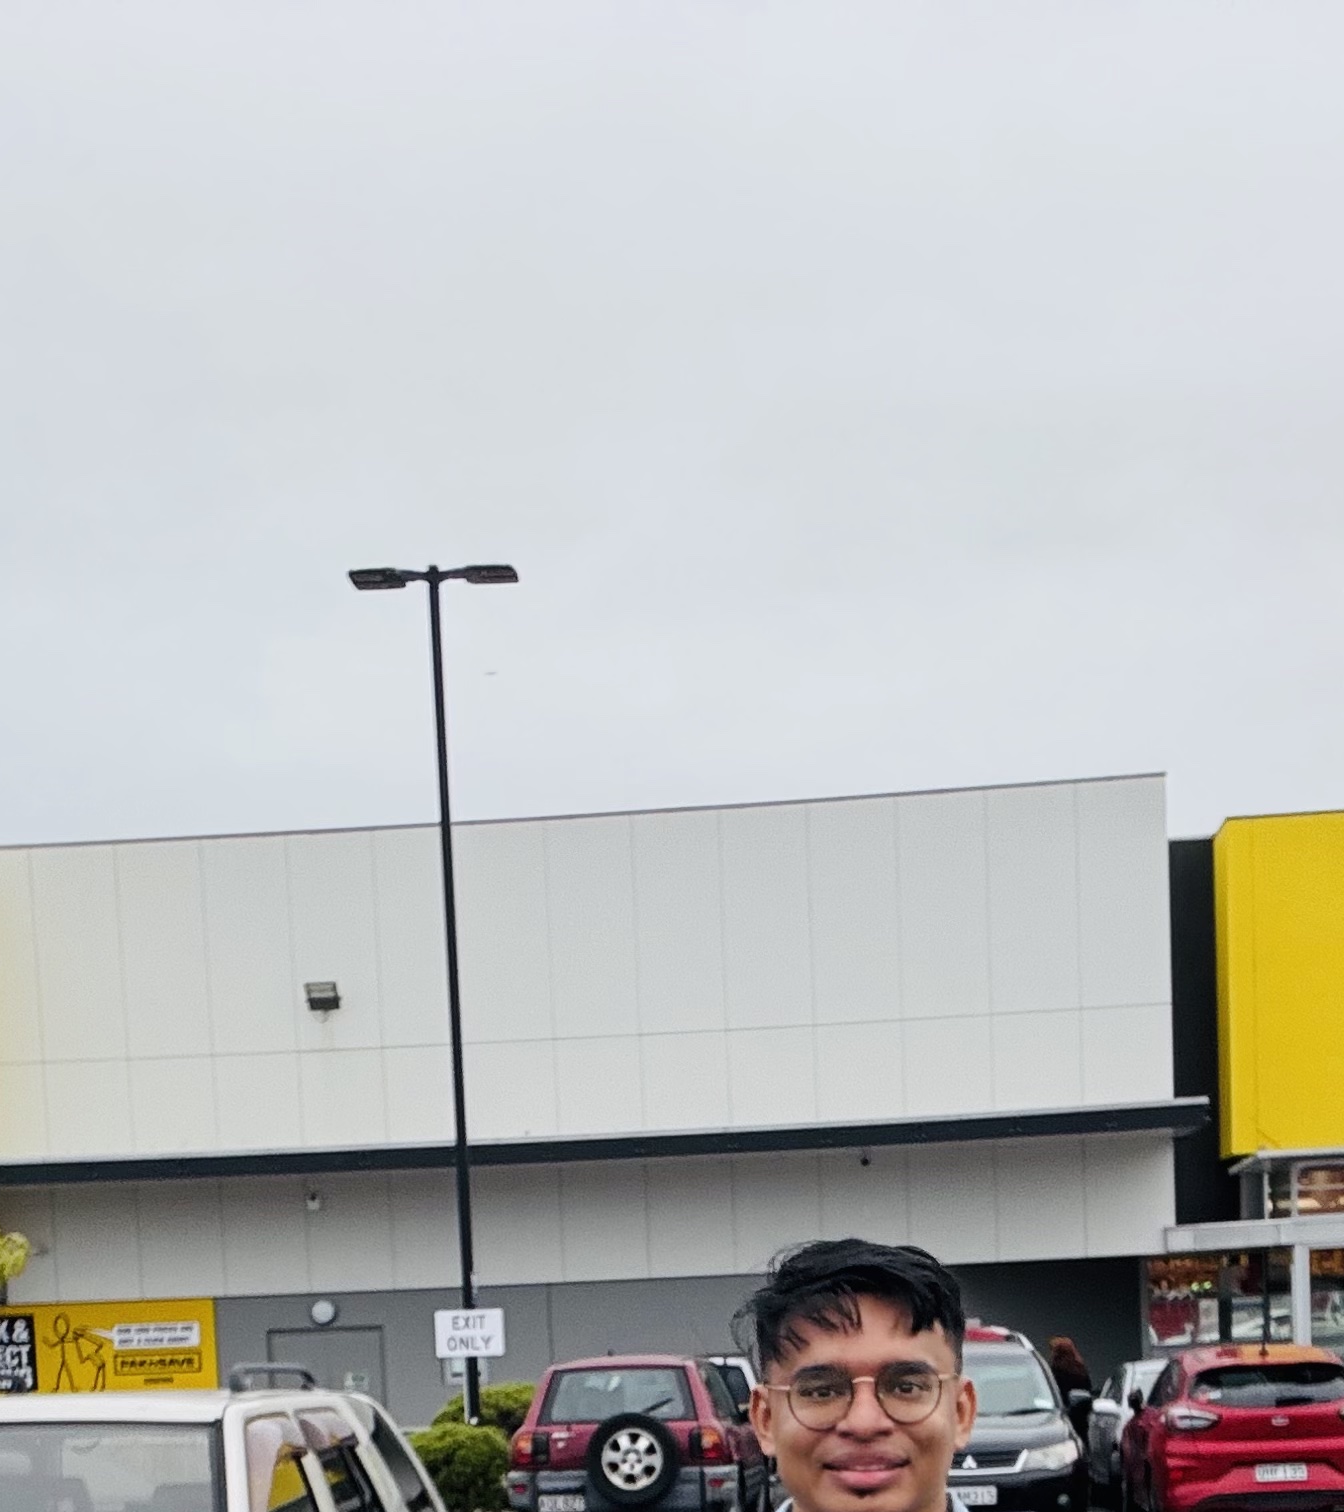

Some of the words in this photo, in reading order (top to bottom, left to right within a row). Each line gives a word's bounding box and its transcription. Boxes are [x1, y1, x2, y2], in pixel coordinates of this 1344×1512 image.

[452, 1315, 485, 1330] EXIT
[12, 1318, 30, 1343] &
[447, 1336, 492, 1351] ONLY
